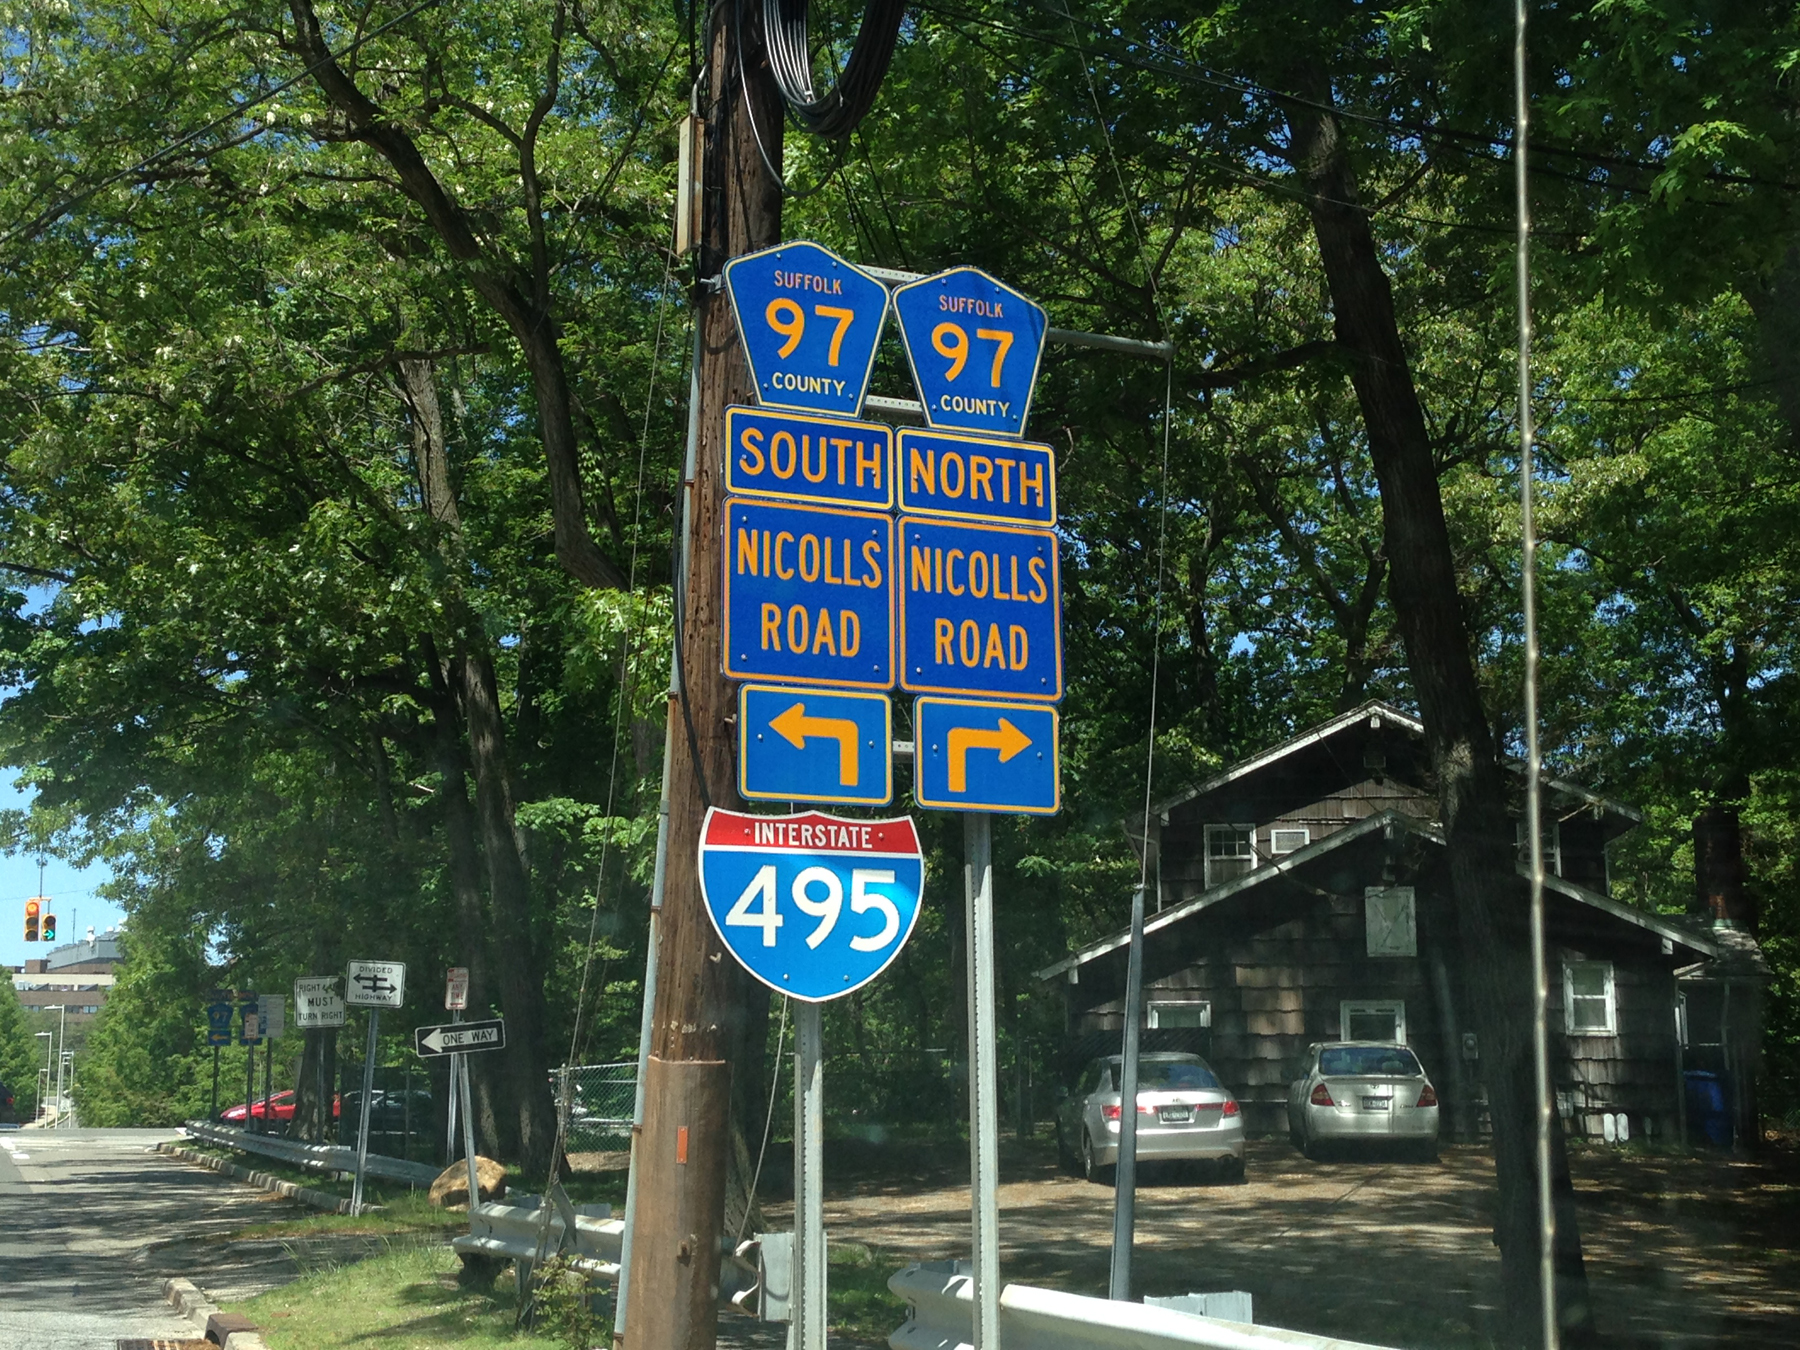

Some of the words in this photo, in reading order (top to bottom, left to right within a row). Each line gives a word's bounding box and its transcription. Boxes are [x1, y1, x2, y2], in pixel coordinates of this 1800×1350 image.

[774, 269, 842, 295] SUFFOLK
[939, 294, 1004, 318] SUFFOLK
[765, 297, 854, 367] 97
[931, 321, 1014, 388] 97
[772, 372, 846, 397] COUNTY
[940, 394, 1010, 418] COUNTY
[739, 427, 881, 489] SOUTH
[910, 447, 1043, 507] NORTH
[737, 527, 882, 589] NICOLLS
[911, 545, 1047, 604] NICOLLS
[760, 602, 861, 657] ROAD
[934, 617, 1029, 671] ROAD
[754, 822, 873, 849] INTERSTATE
[725, 864, 900, 952] 495
[359, 965, 393, 974] DIVIDED
[299, 984, 320, 993] RIGHT
[307, 996, 334, 1007] MUST
[355, 993, 392, 1001] HIGHWAY
[299, 1012, 318, 1021] TURN
[321, 1011, 343, 1020] RIGHT
[443, 1033, 464, 1045] ONE
[471, 1030, 494, 1042] WAY
